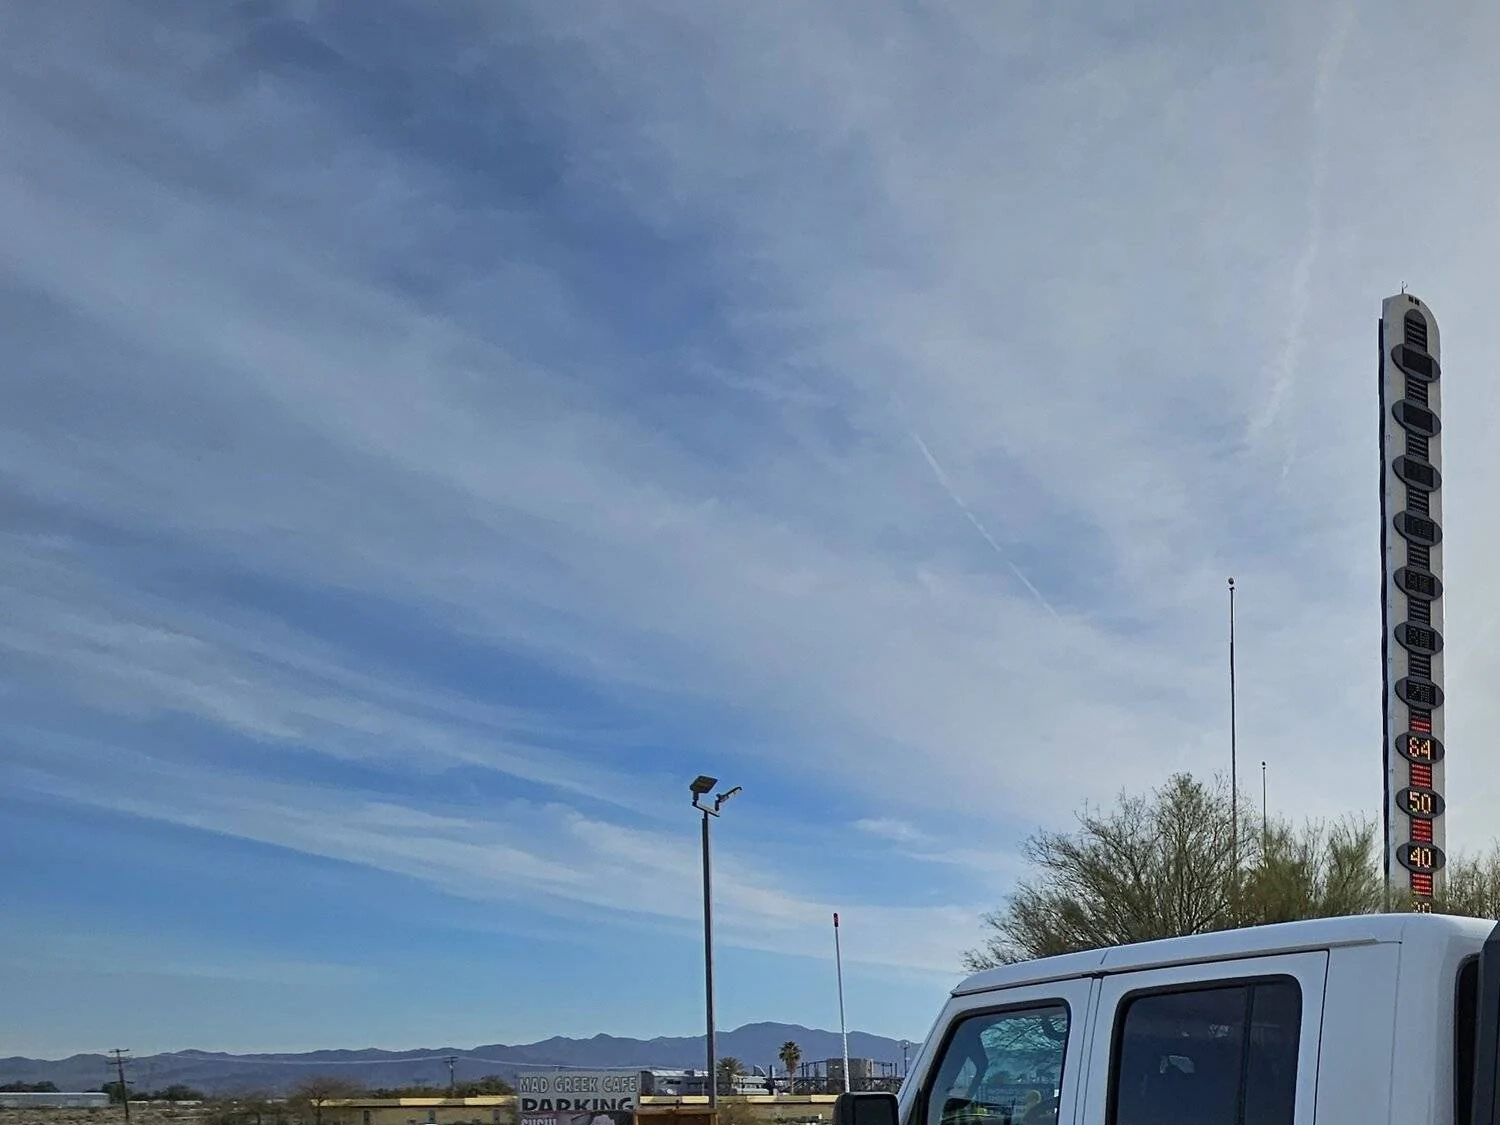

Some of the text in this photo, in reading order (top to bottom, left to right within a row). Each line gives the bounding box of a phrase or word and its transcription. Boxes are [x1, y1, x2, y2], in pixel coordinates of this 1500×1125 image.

[1409, 737, 1431, 761] 64
[1409, 791, 1432, 815] 50
[1410, 846, 1432, 868] 40
[519, 1075, 637, 1093] MAD GREEK CAFE
